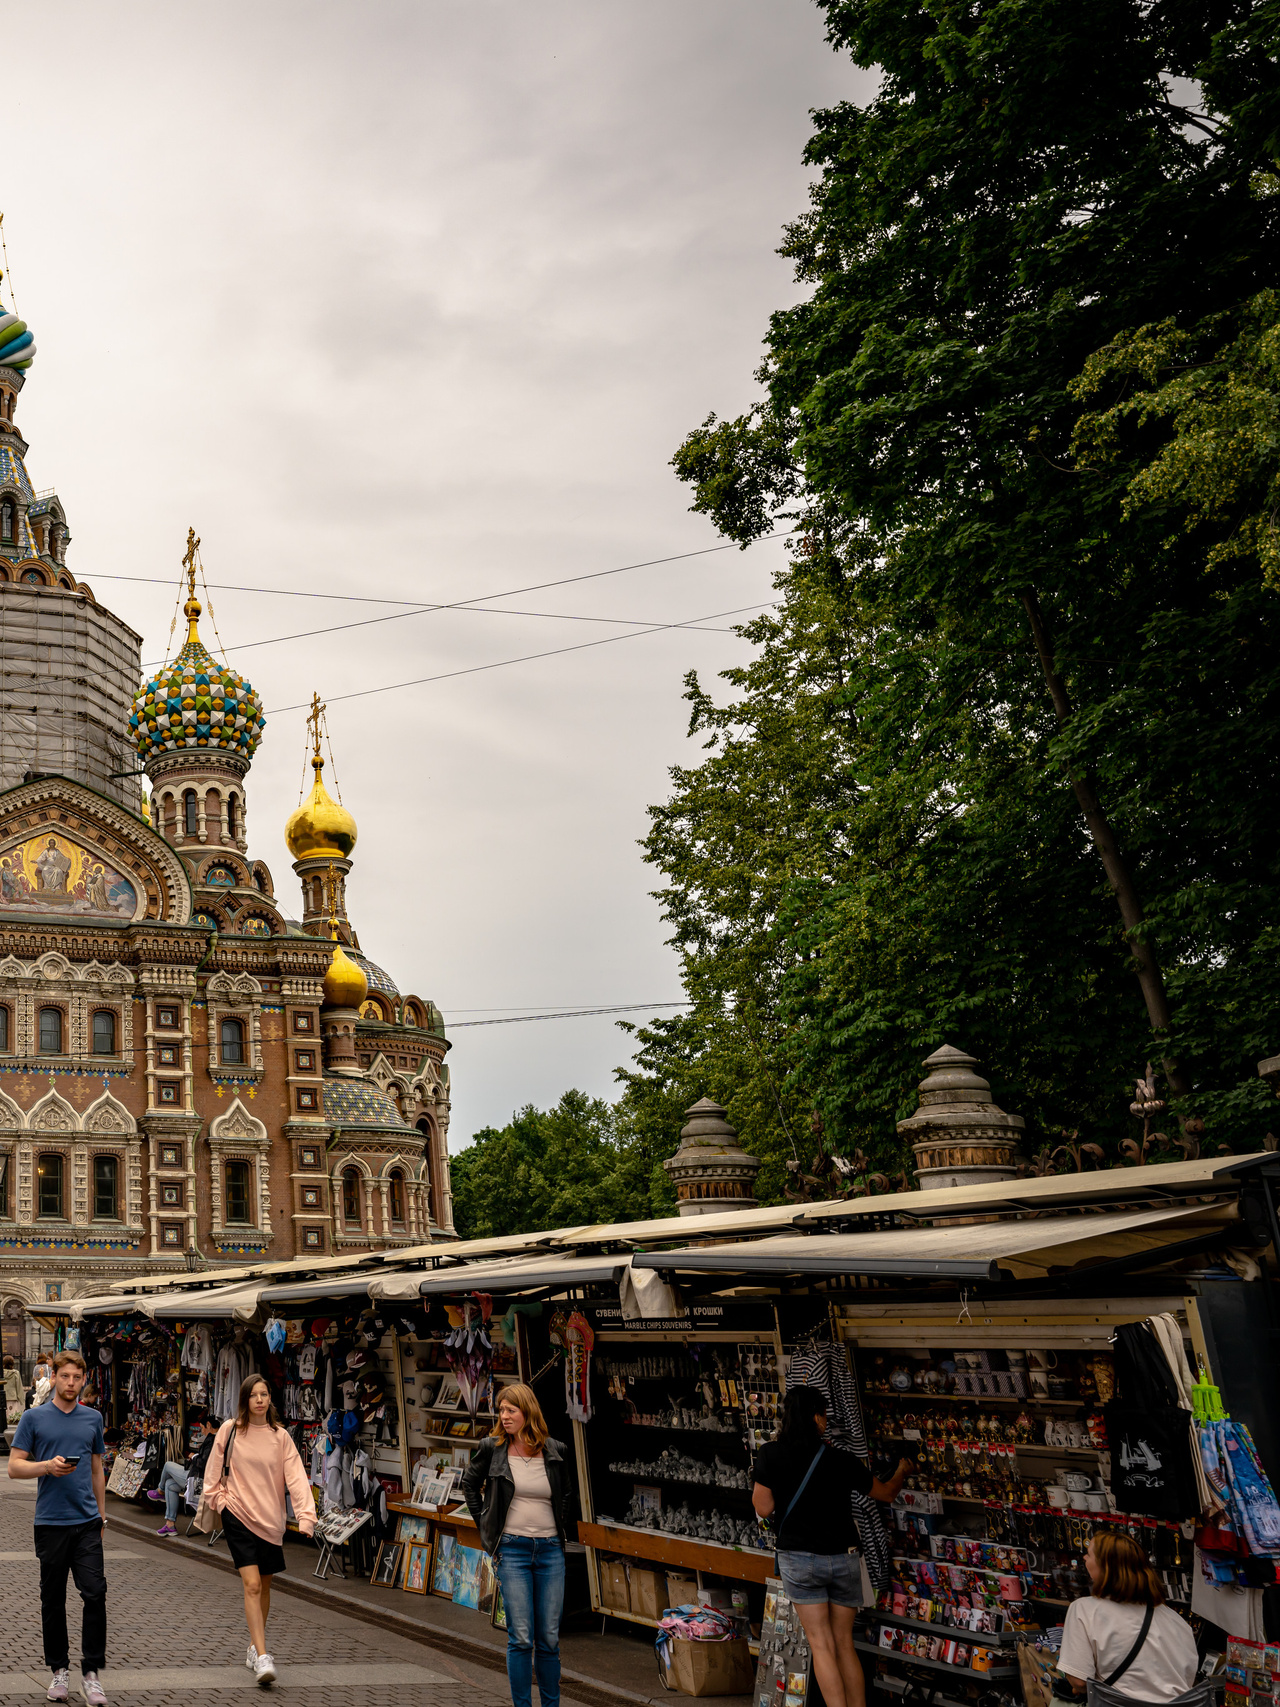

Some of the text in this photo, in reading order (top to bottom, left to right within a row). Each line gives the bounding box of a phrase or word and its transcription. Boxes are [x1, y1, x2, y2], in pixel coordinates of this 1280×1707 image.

[595, 1309, 622, 1317] СУВЕНИ
[693, 1306, 723, 1316] КРОШКИ
[624, 1321, 692, 1329] MARBLE CHIPS SOUVENIRS
